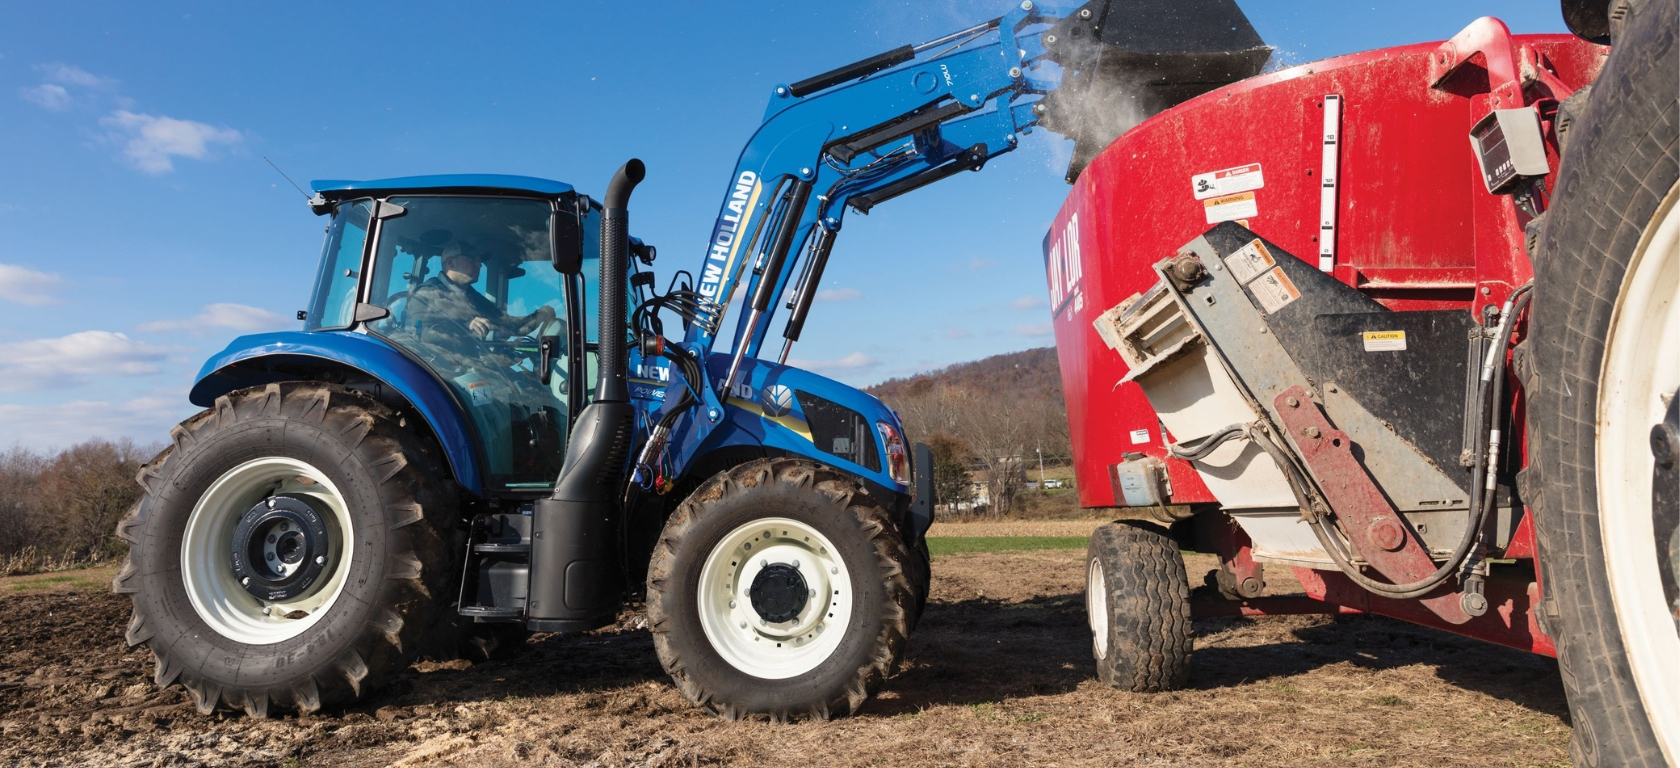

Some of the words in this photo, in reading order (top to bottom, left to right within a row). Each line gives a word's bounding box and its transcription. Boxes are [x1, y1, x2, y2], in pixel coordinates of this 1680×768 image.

[710, 170, 757, 262] HOLLAND
[1220, 195, 1245, 204] WARNING
[1050, 237, 1064, 312] JAY
[1063, 212, 1083, 293] LOR
[637, 364, 669, 382] NEW
